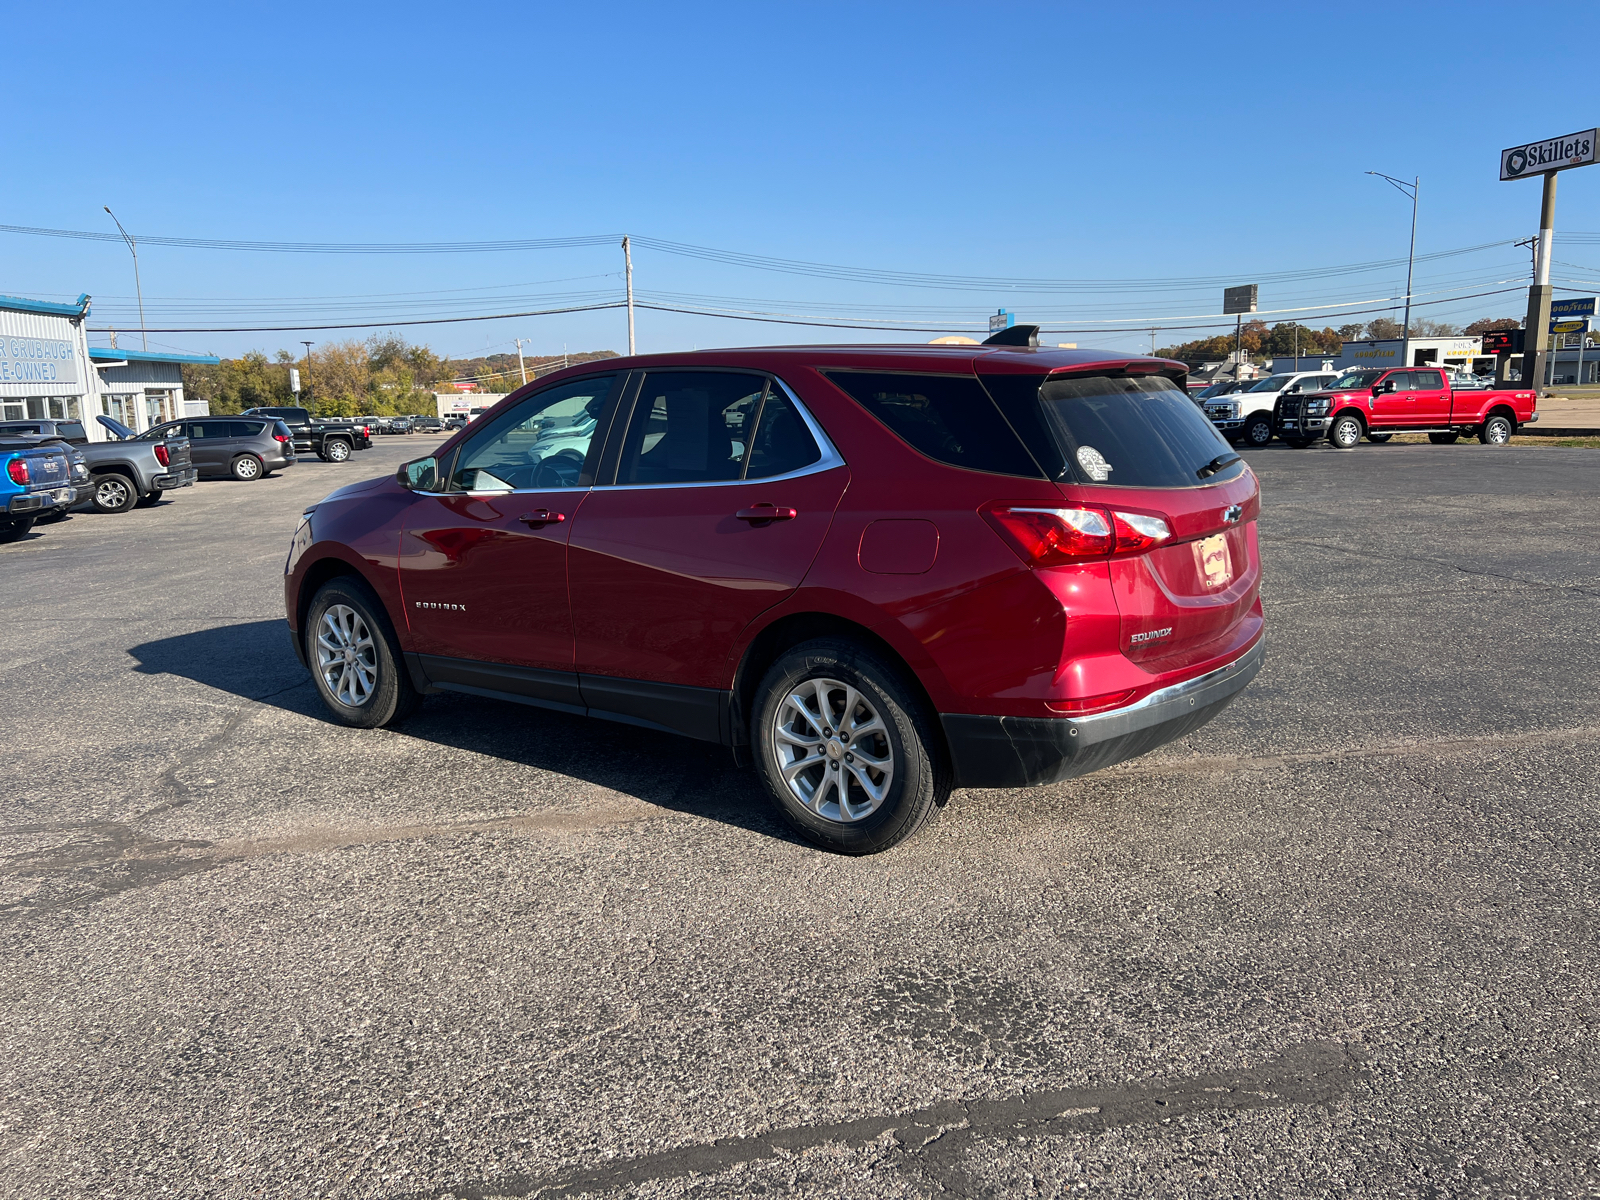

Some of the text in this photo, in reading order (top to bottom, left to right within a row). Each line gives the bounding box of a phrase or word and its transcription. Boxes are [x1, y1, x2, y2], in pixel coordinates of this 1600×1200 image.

[1528, 139, 1590, 166] Skillets
[1552, 302, 1593, 313] OODYEAR
[0, 338, 73, 360] R GRUBAUGH
[0, 361, 56, 380] E-OWNED
[416, 602, 466, 611] EQUINOX
[1130, 626, 1173, 643] EQUINOX
